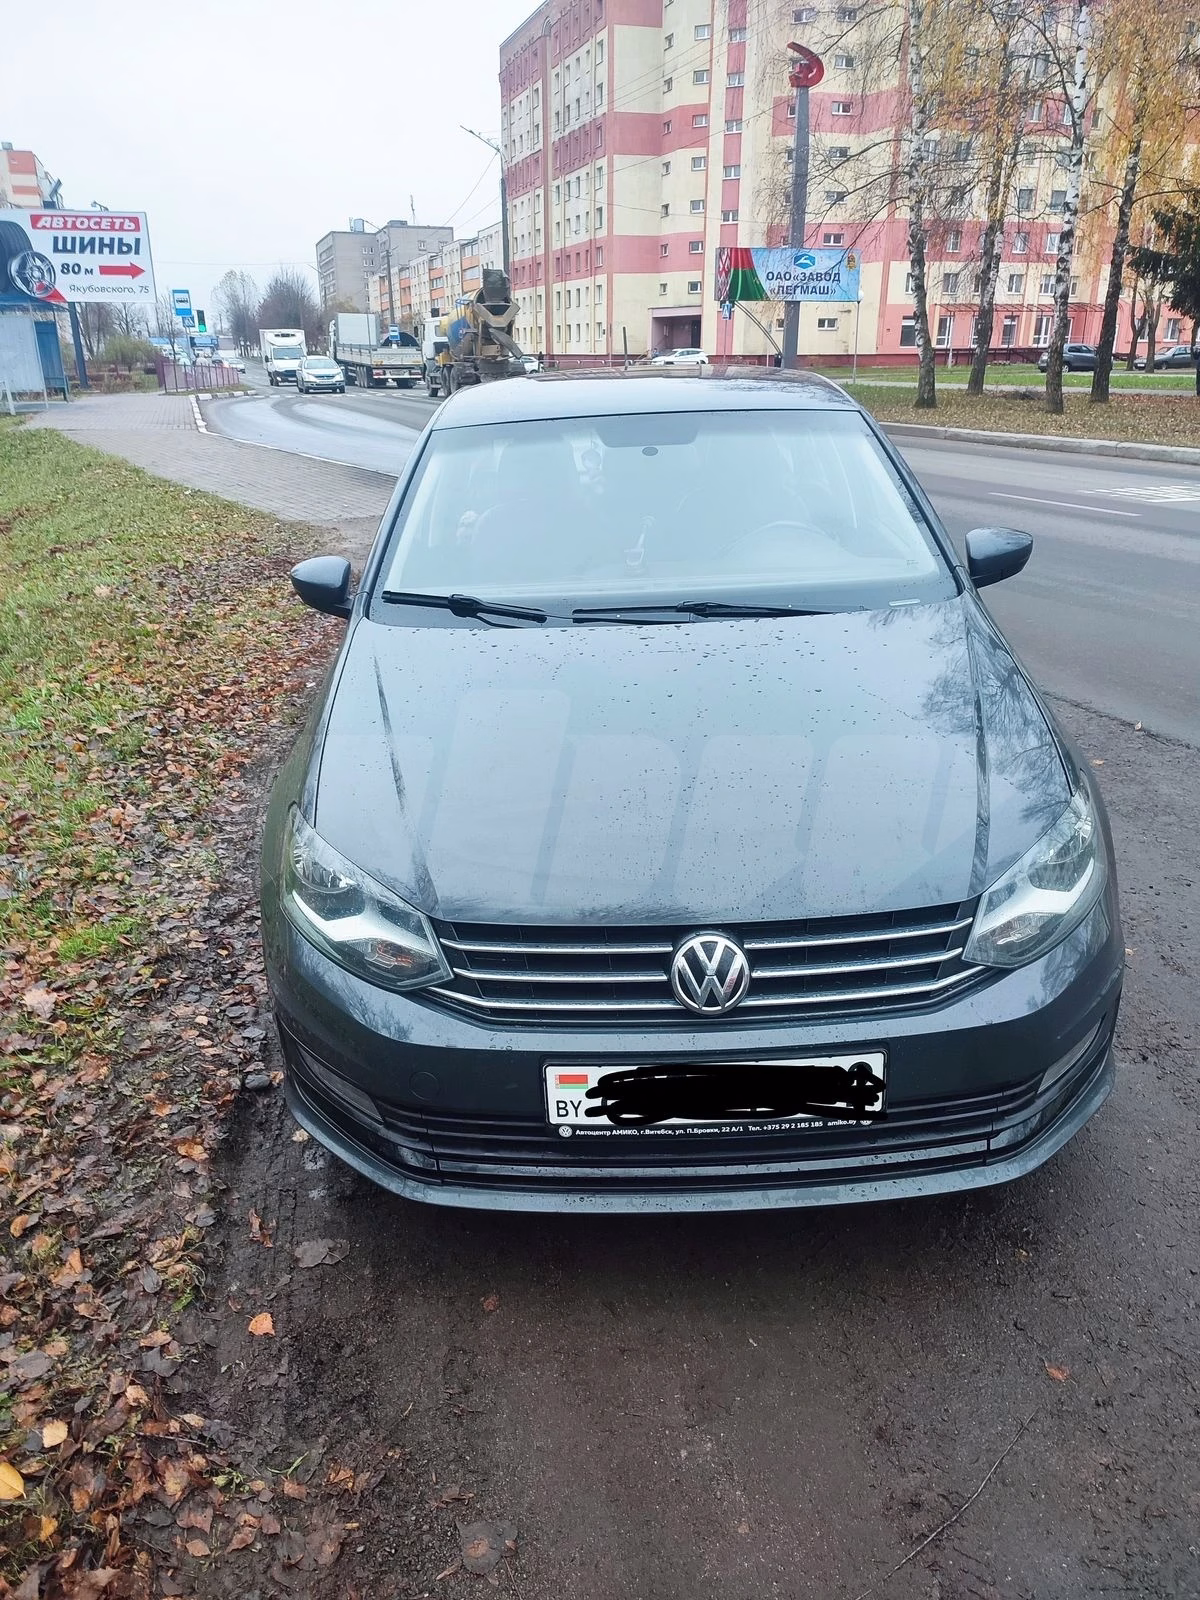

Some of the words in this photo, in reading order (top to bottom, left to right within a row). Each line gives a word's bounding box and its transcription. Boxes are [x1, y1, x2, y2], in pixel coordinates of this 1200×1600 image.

[37, 216, 136, 230] АВТОСЕТЬ
[52, 235, 141, 256] ШИНЫ
[60, 262, 82, 275] 80
[84, 267, 94, 276] м
[69, 284, 136, 295] Якубовского,
[139, 285, 150, 294] 75
[555, 1099, 583, 1118] BY
[575, 1129, 611, 1137] Автоцентр
[763, 1123, 780, 1131] +375
[810, 1120, 824, 1128] 185
